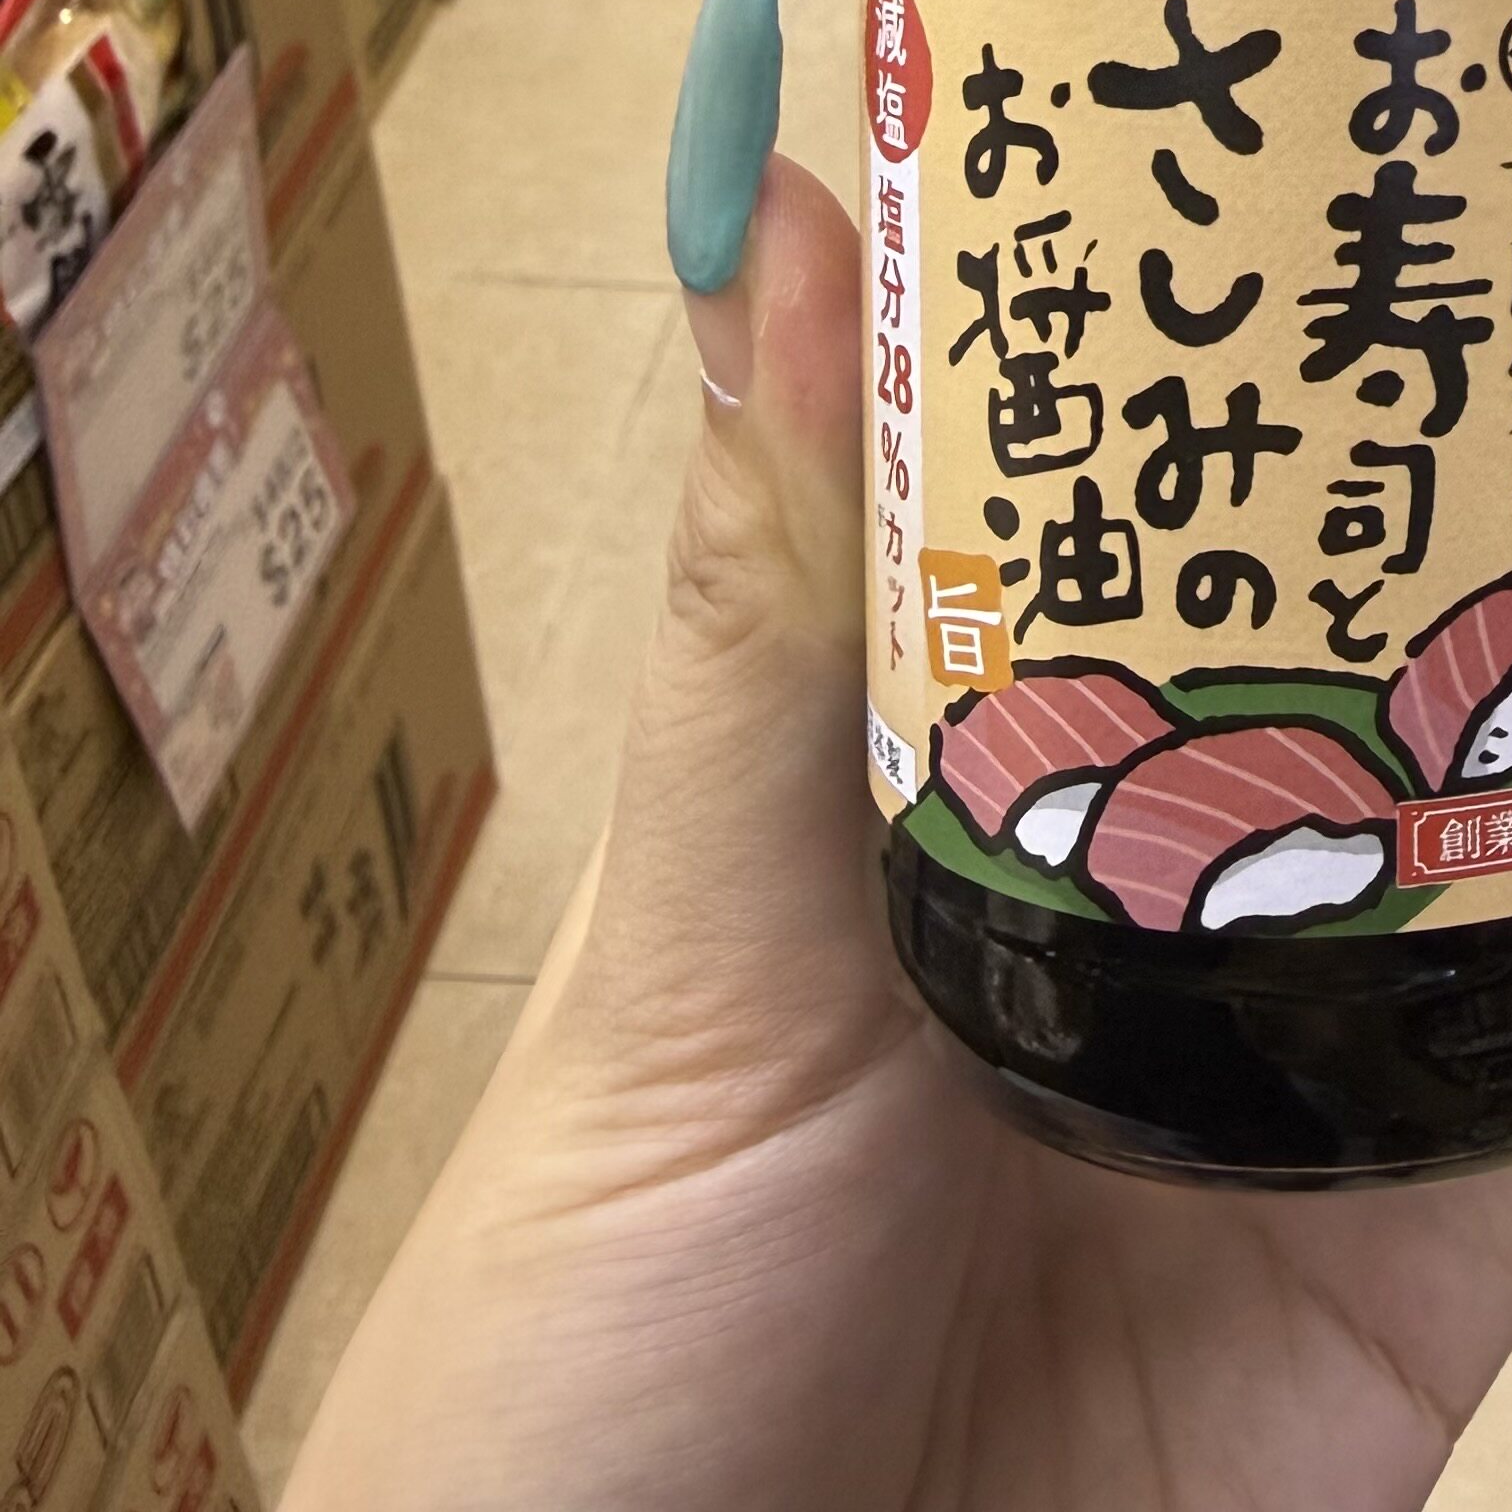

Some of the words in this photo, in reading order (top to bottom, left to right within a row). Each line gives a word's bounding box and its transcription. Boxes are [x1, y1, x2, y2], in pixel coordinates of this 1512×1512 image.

[949, 43, 1145, 643] お醤油
[928, 575, 1003, 676] 旨
